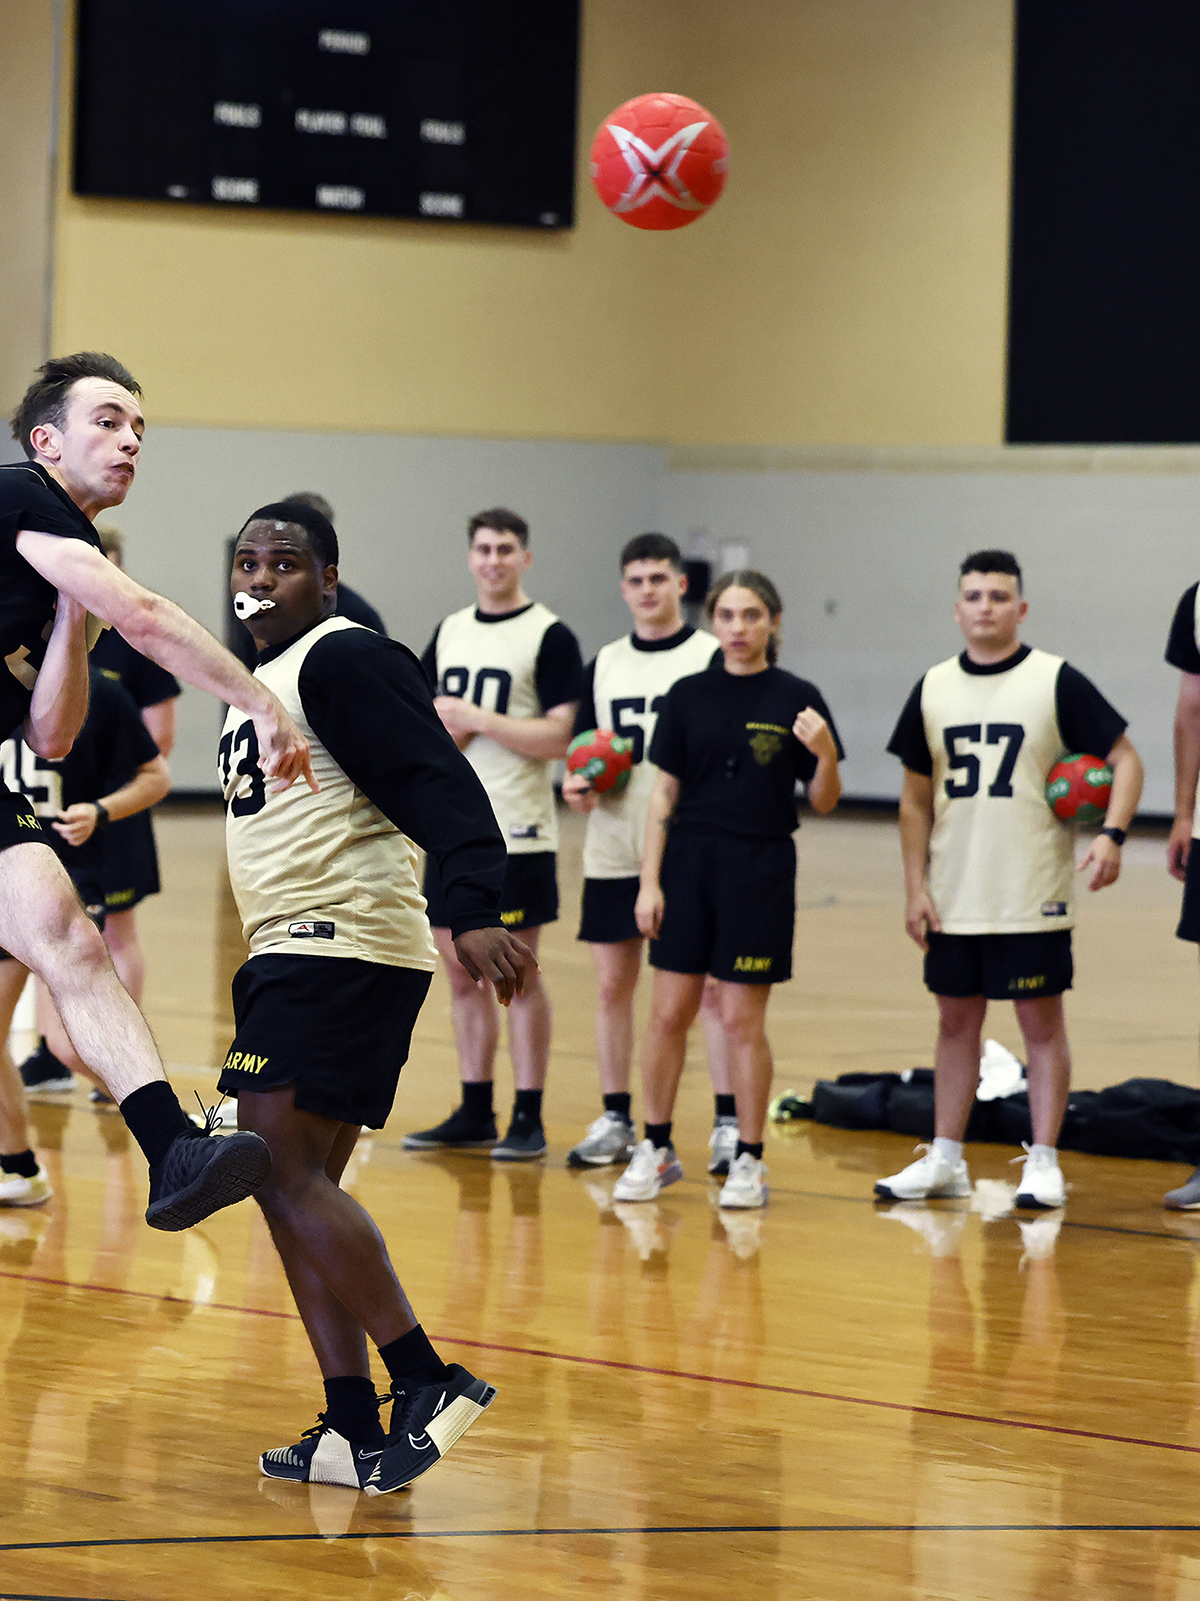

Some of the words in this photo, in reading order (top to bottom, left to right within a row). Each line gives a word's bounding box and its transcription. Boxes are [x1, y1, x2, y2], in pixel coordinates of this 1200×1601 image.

[944, 724, 1025, 799] 57
[16, 813, 42, 830] AR
[733, 955, 772, 971] ARMY
[223, 1052, 269, 1075] ARMY
